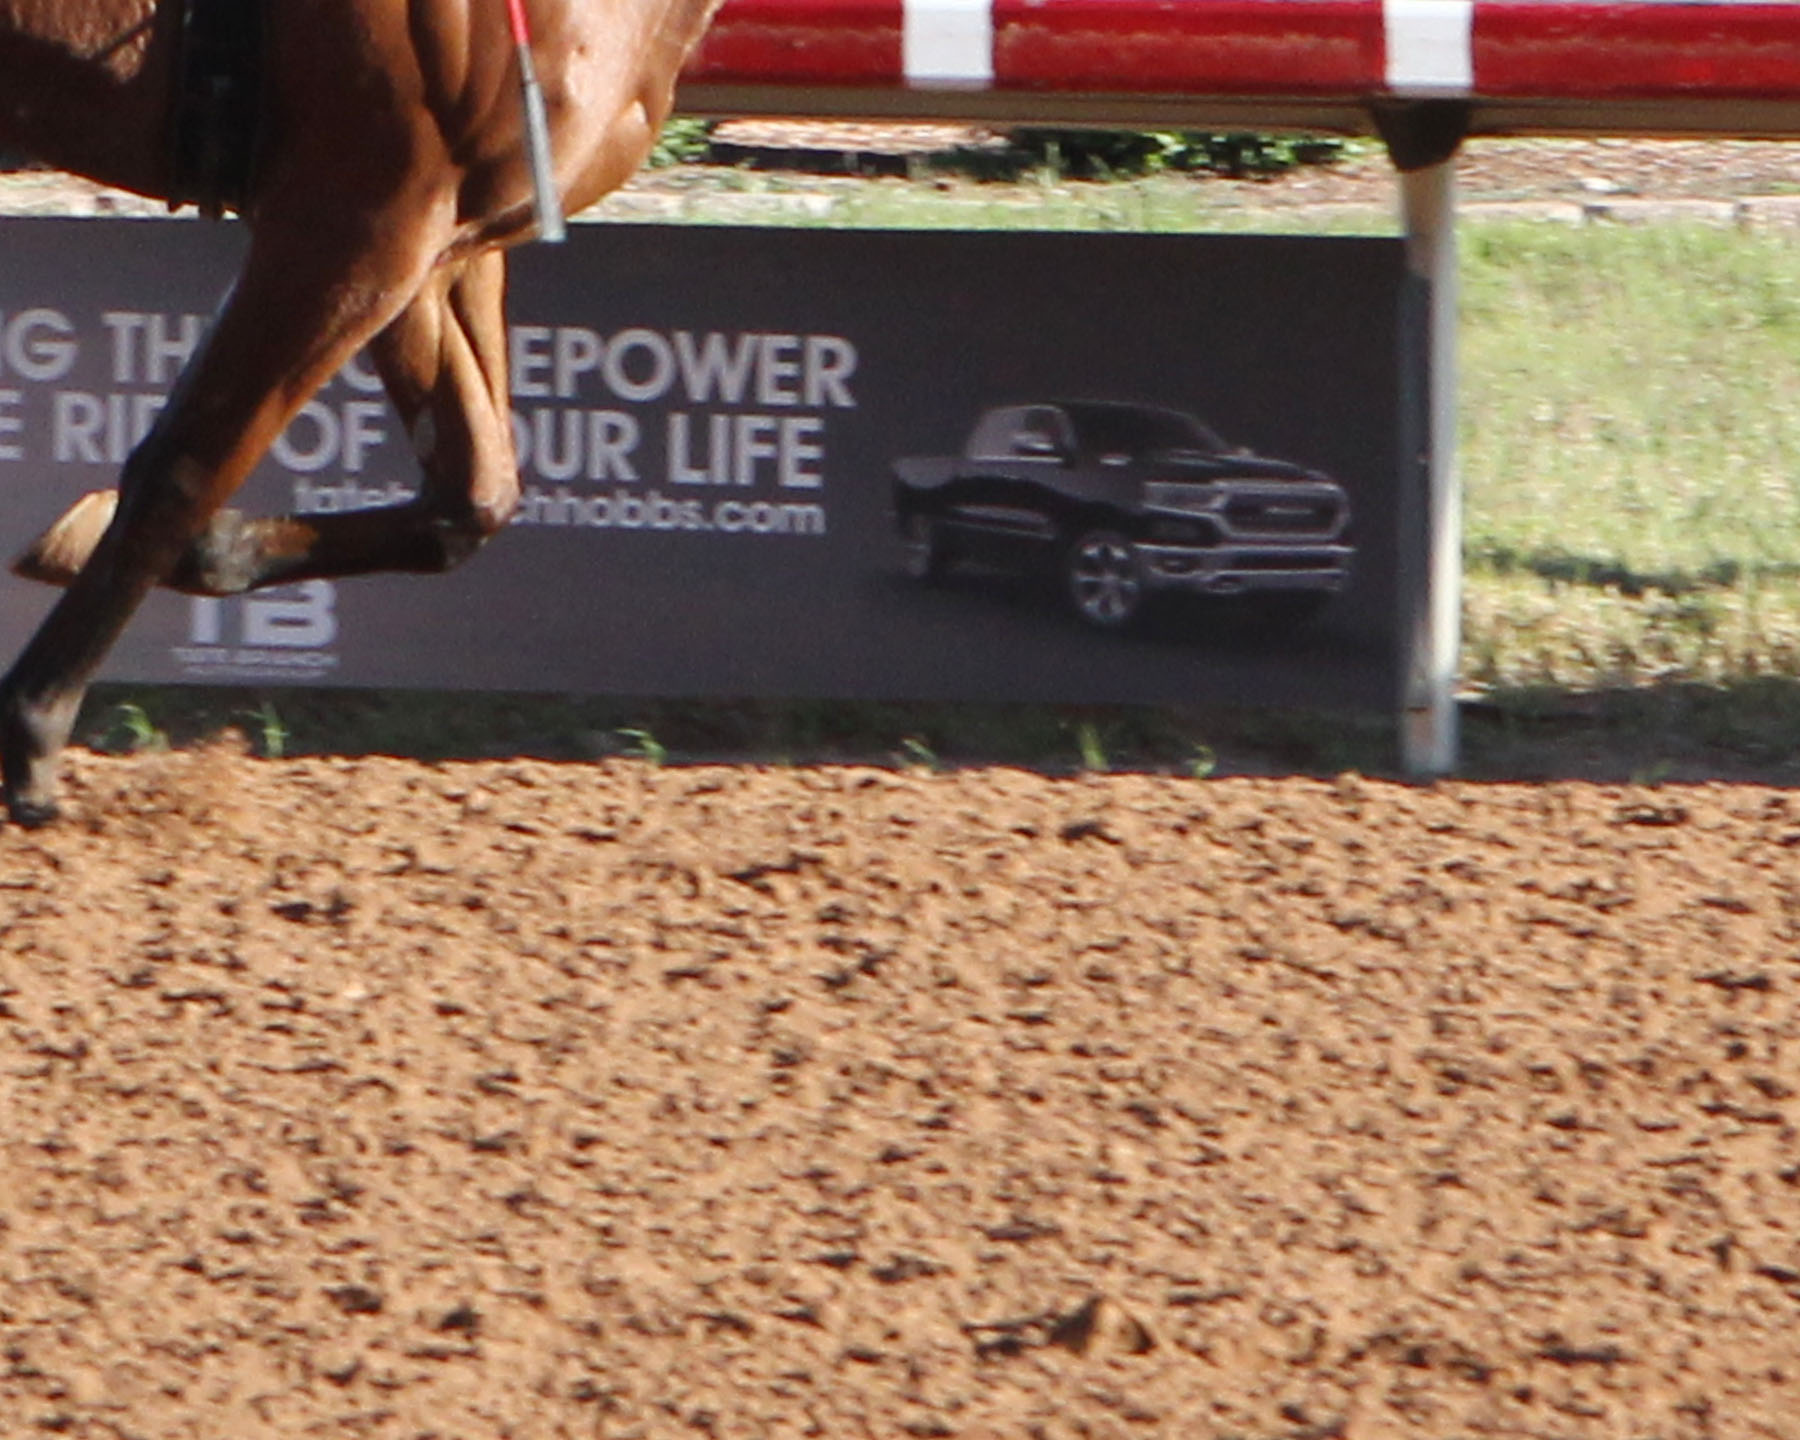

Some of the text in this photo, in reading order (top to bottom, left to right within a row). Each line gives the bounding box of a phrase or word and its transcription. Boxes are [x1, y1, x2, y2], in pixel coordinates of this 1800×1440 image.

[101, 312, 216, 384] TH
[55, 389, 169, 465] RI
[271, 401, 387, 473] OF
[512, 409, 640, 482] UR
[667, 411, 825, 488] LIFE
[294, 477, 827, 535] tatebchhobbs.com
